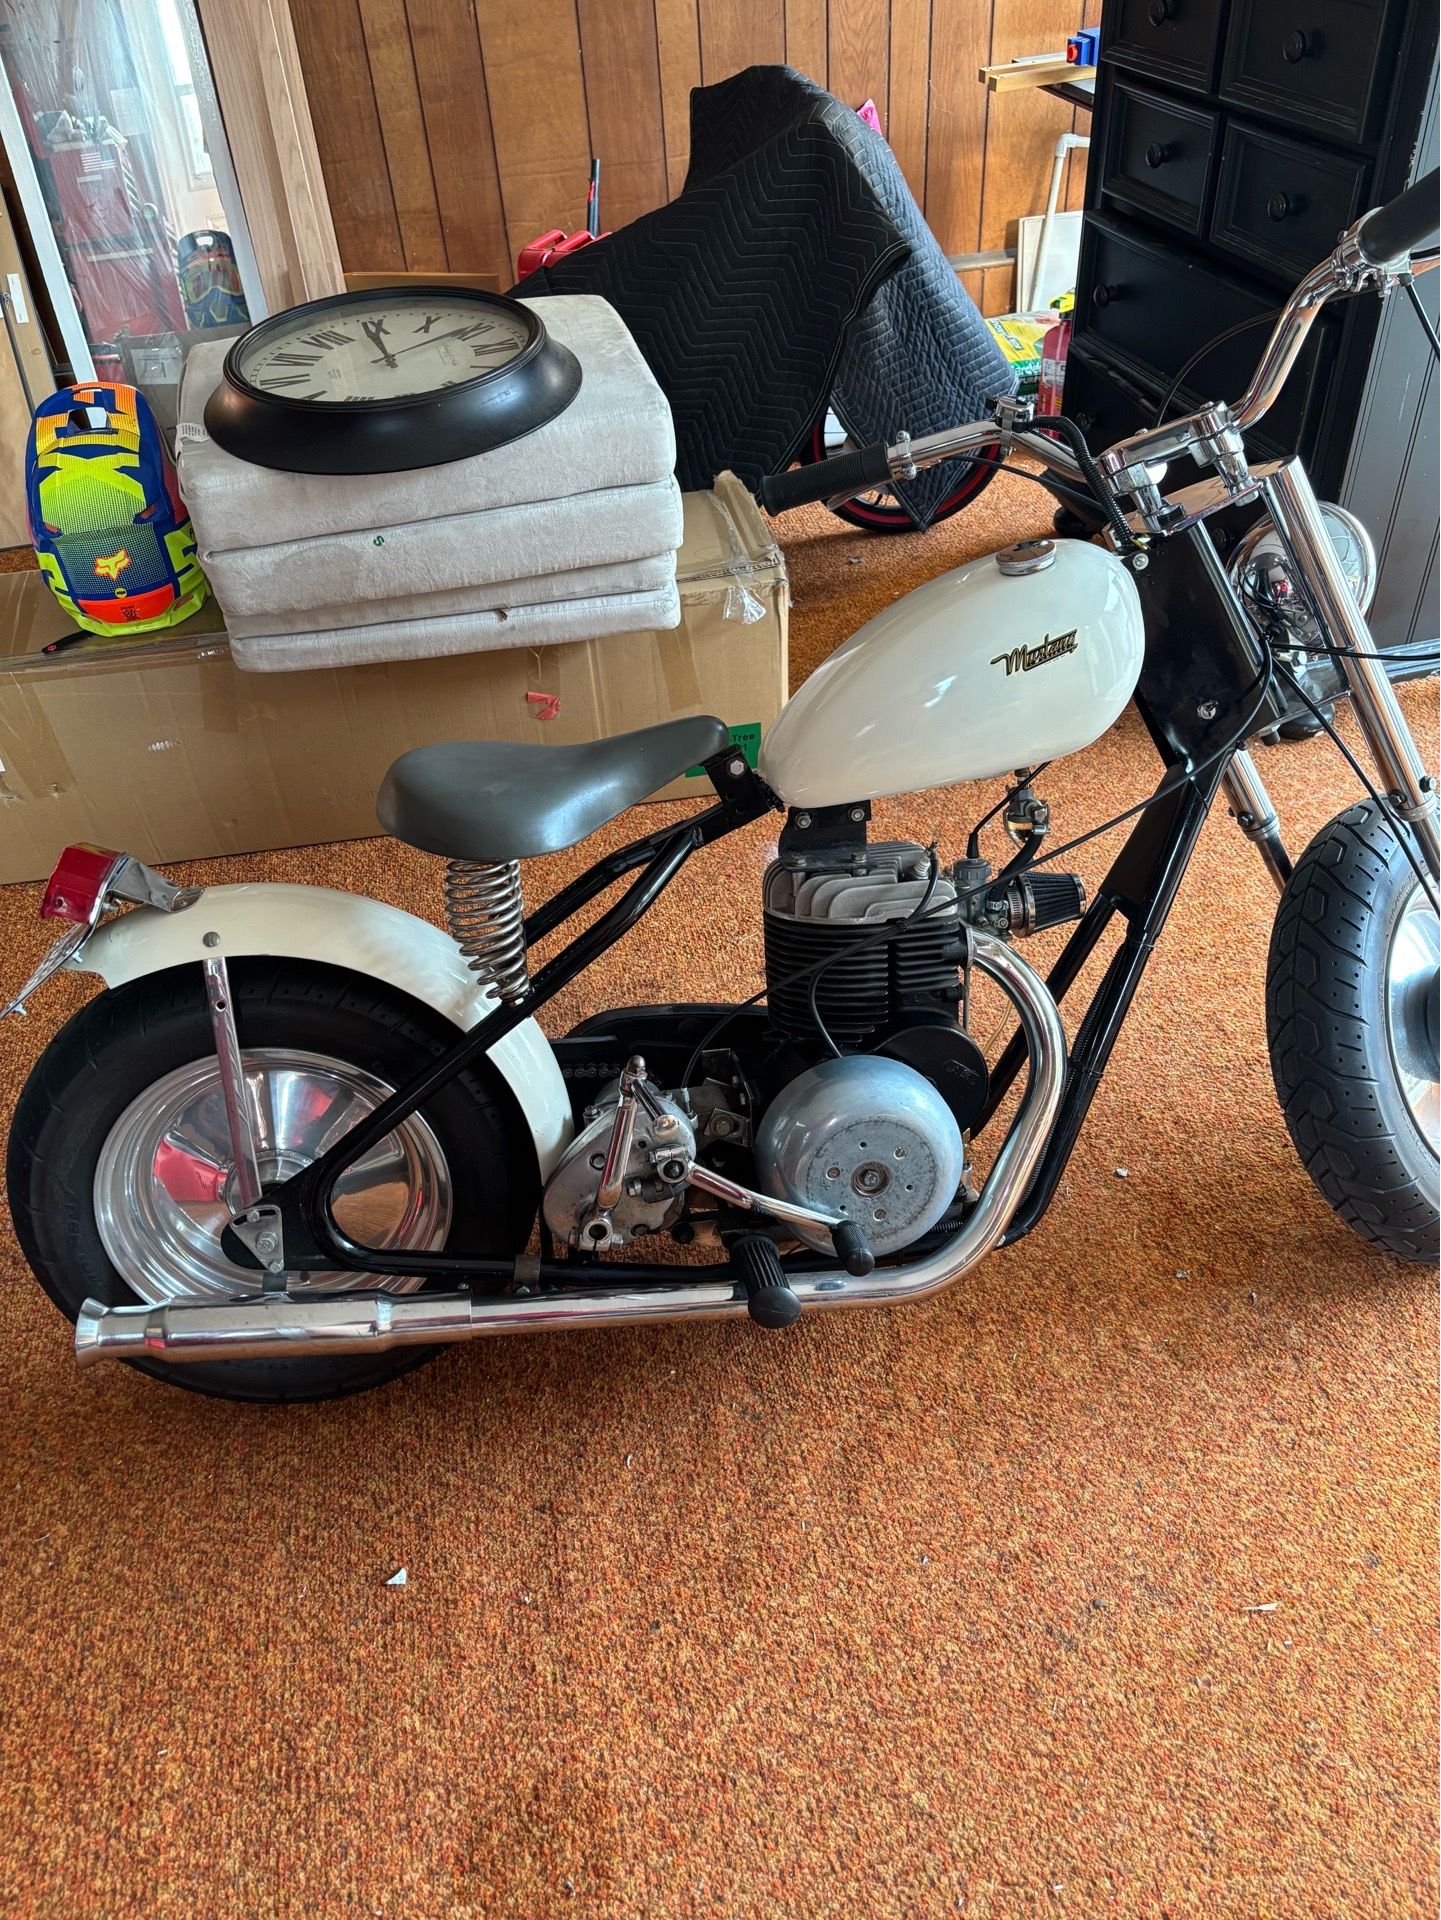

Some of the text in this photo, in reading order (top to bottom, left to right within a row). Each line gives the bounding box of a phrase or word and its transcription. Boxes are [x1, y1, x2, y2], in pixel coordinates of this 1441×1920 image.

[413, 316, 442, 334] X
[300, 330, 357, 351] VIII
[471, 337, 519, 357] XII
[265, 353, 325, 366] VII
[731, 733, 755, 742] Tree
